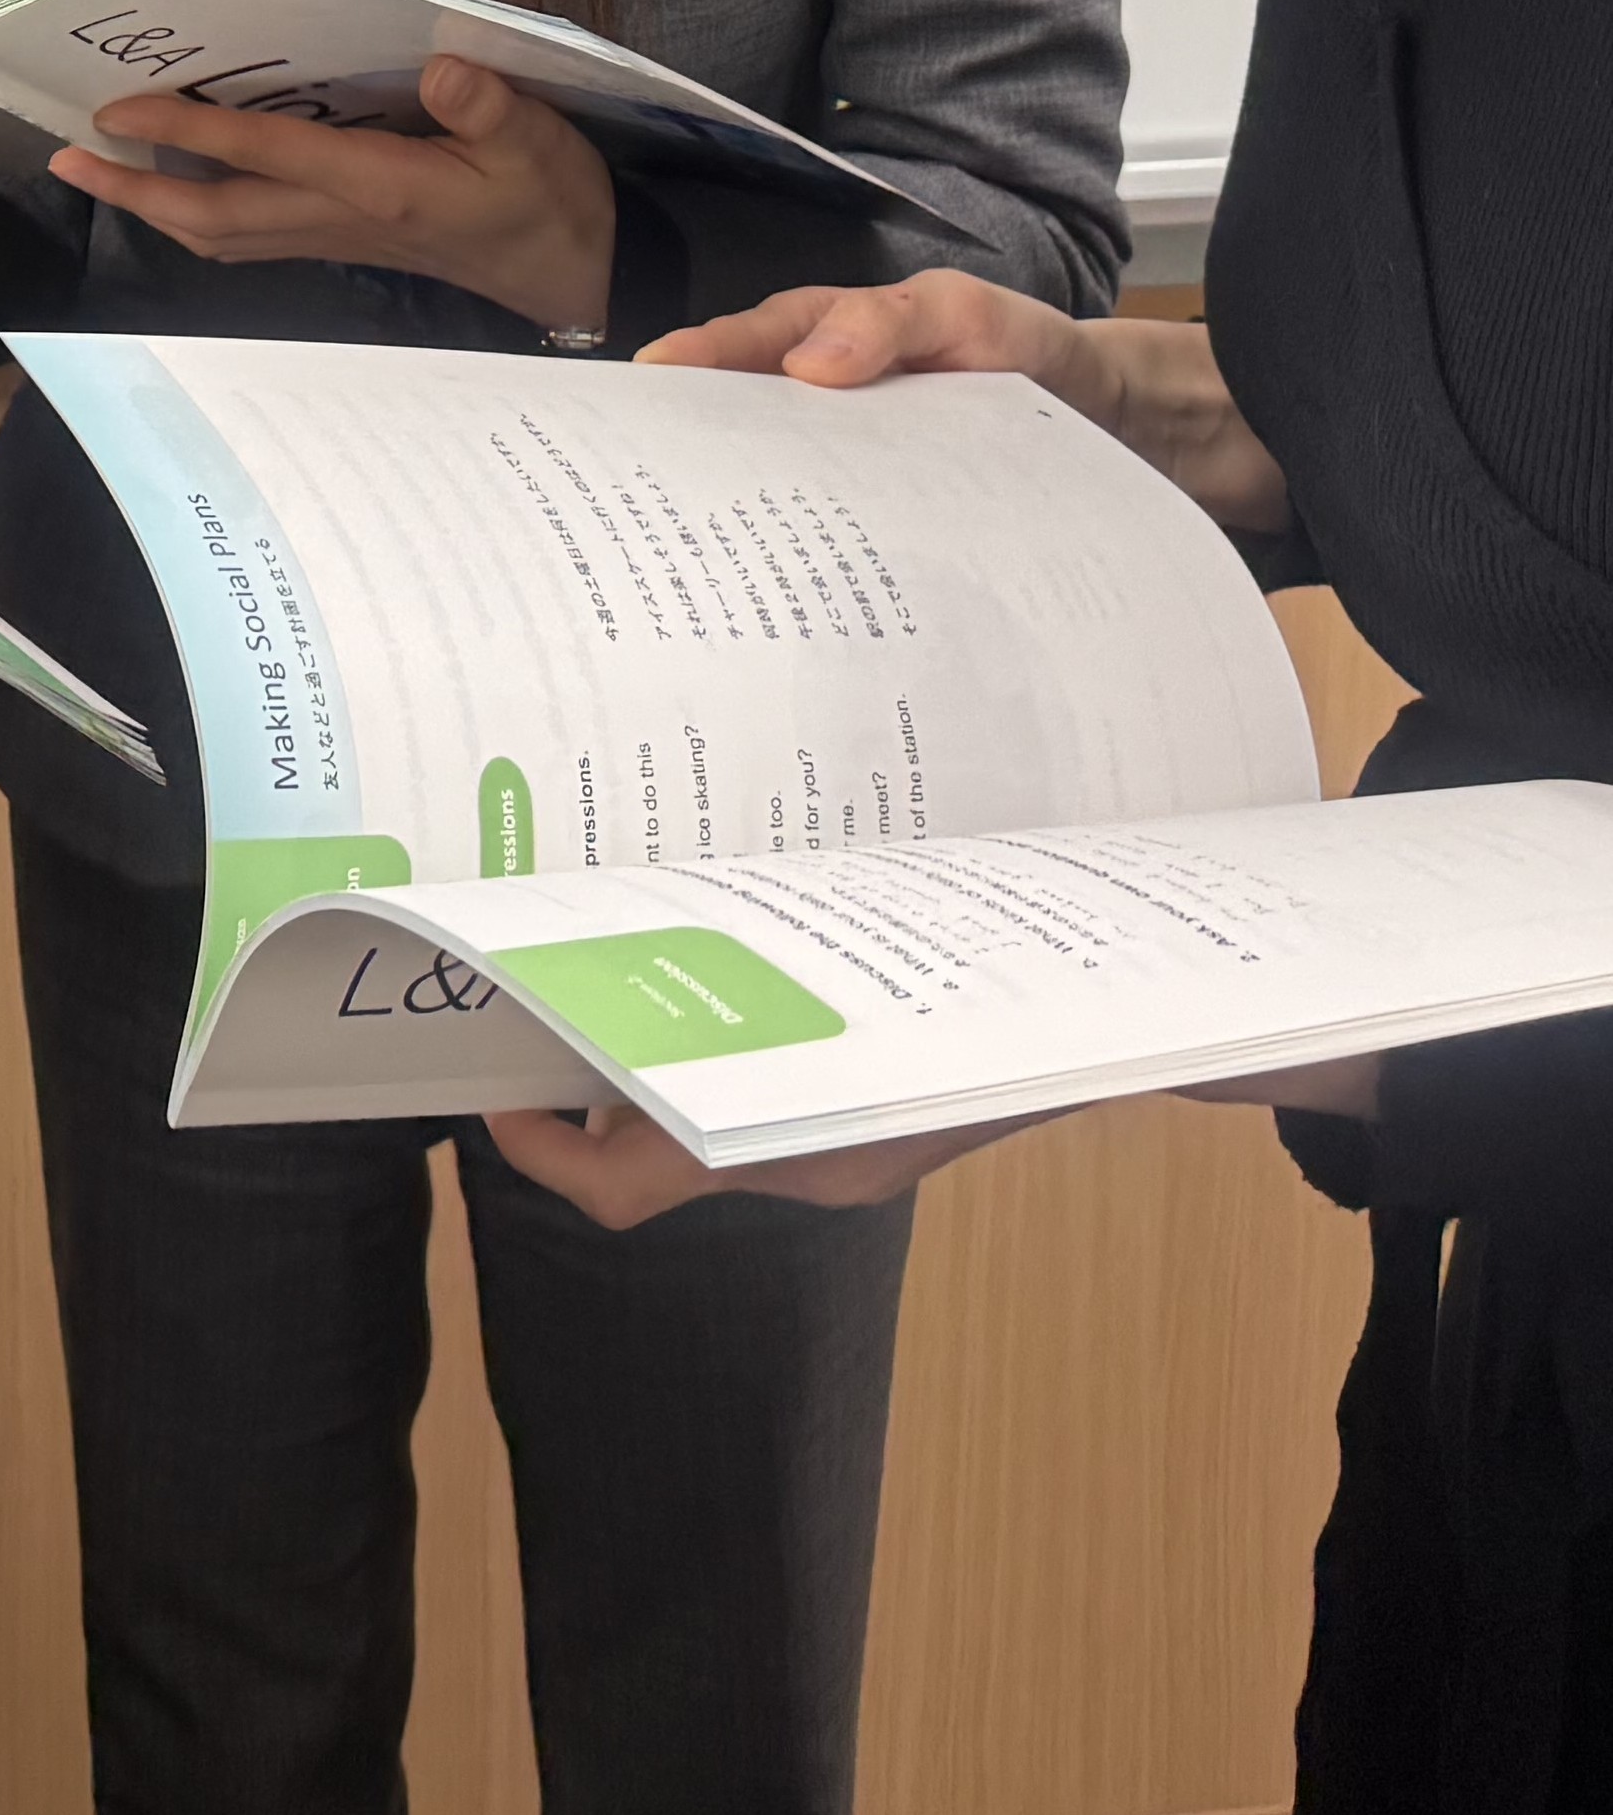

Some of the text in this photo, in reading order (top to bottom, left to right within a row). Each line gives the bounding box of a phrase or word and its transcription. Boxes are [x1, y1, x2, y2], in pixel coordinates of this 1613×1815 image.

[69, 9, 205, 77] L&A
[185, 494, 299, 789] Making Social Plans
[897, 694, 920, 765] station.
[637, 743, 654, 778] this
[797, 748, 821, 798] you?
[643, 785, 657, 811] do
[684, 724, 711, 847] ice skating?
[871, 772, 891, 834] meet?
[907, 771, 924, 803] the
[645, 817, 659, 836] to
[770, 790, 783, 828] too.
[804, 803, 819, 831] for
[843, 798, 856, 836] me.
[909, 808, 926, 829] of
